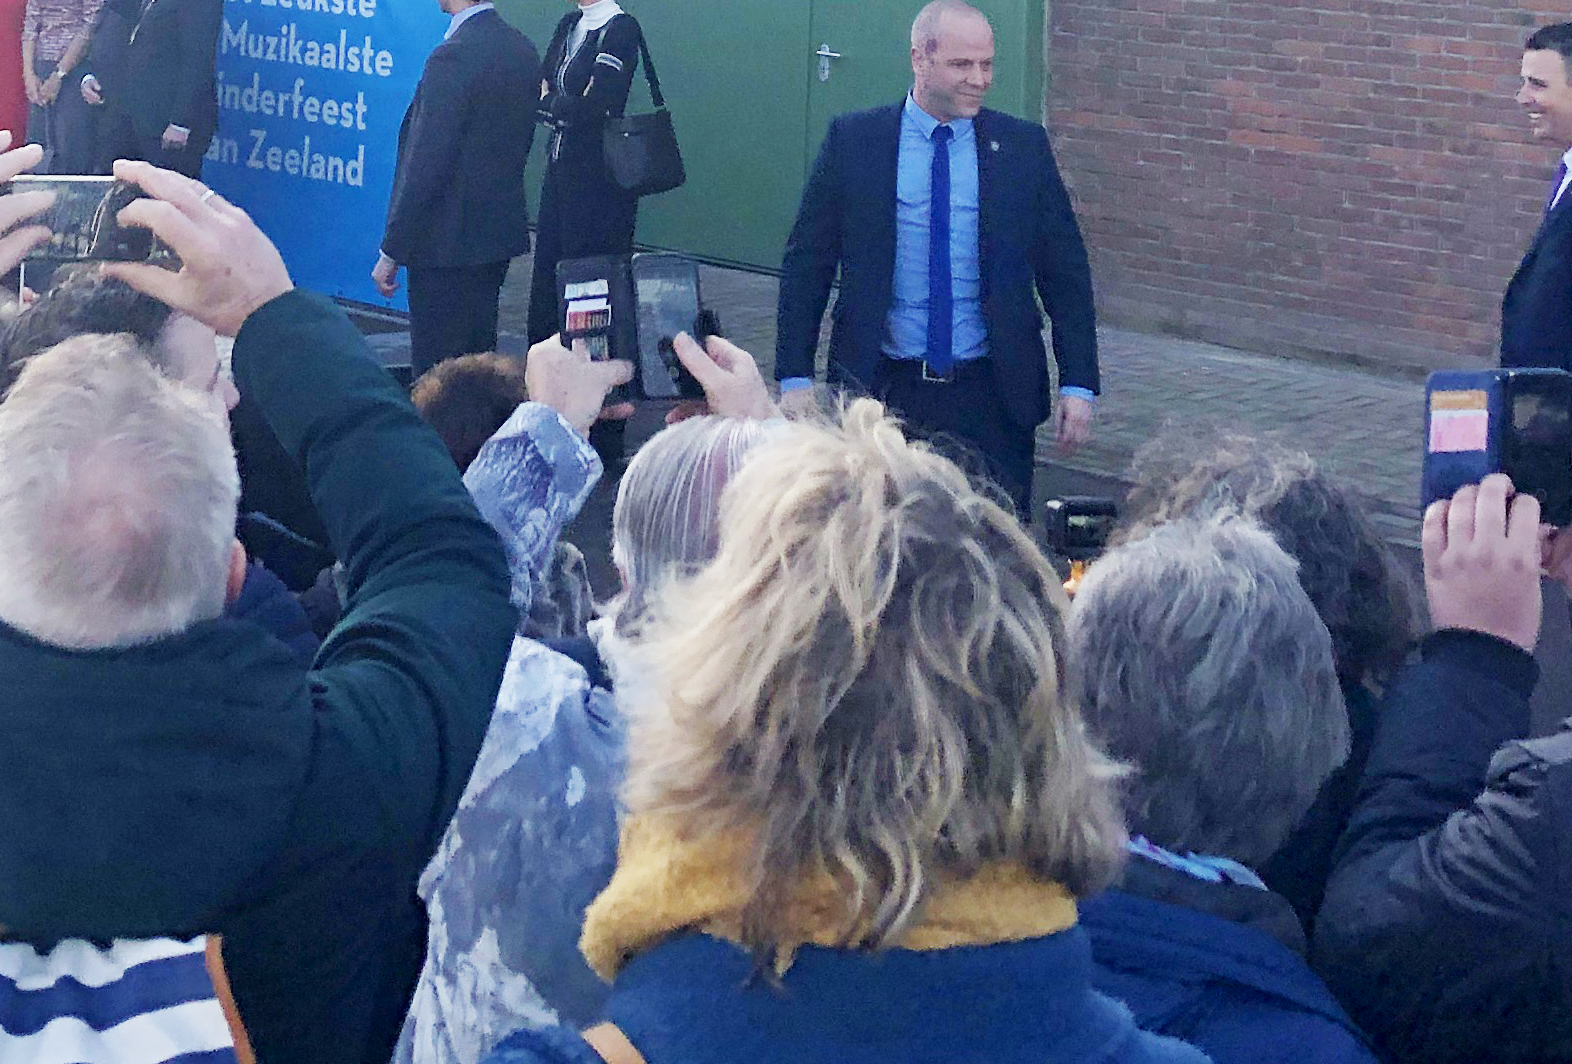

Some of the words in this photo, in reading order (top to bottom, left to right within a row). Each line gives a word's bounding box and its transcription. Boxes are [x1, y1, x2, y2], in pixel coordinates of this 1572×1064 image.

[221, 18, 394, 76] Muzikaalste
[216, 71, 368, 131] inderfeest
[205, 135, 239, 165] an
[246, 128, 366, 187] Zeeland
